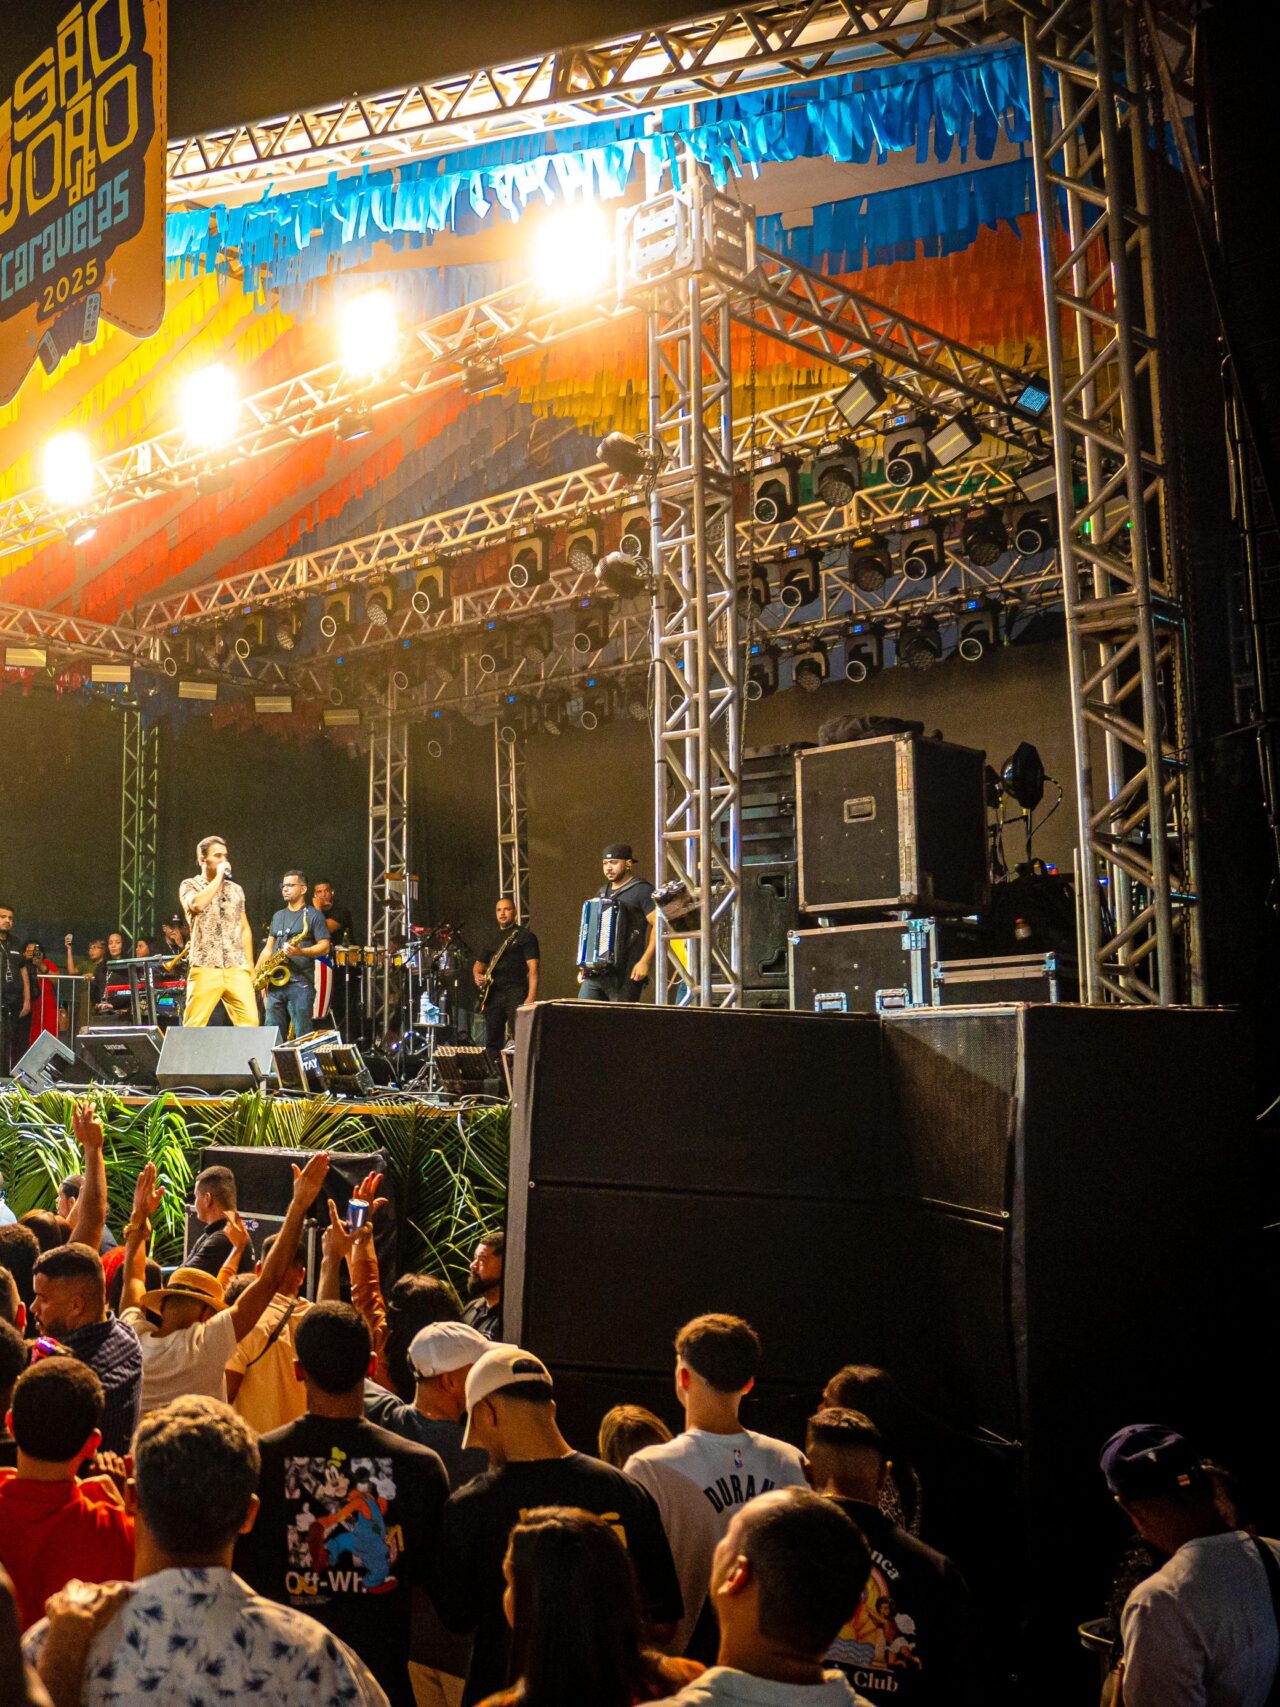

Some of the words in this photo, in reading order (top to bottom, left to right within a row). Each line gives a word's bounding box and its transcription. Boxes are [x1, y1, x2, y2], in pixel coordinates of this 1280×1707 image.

[14, 0, 131, 142] SÃO
[68, 149, 95, 206] de
[43, 257, 98, 312] 2025
[303, 1057, 318, 1071] TAY
[704, 1475, 775, 1514] DURAN
[871, 1550, 900, 1580] nca
[854, 1671, 899, 1692] Club
